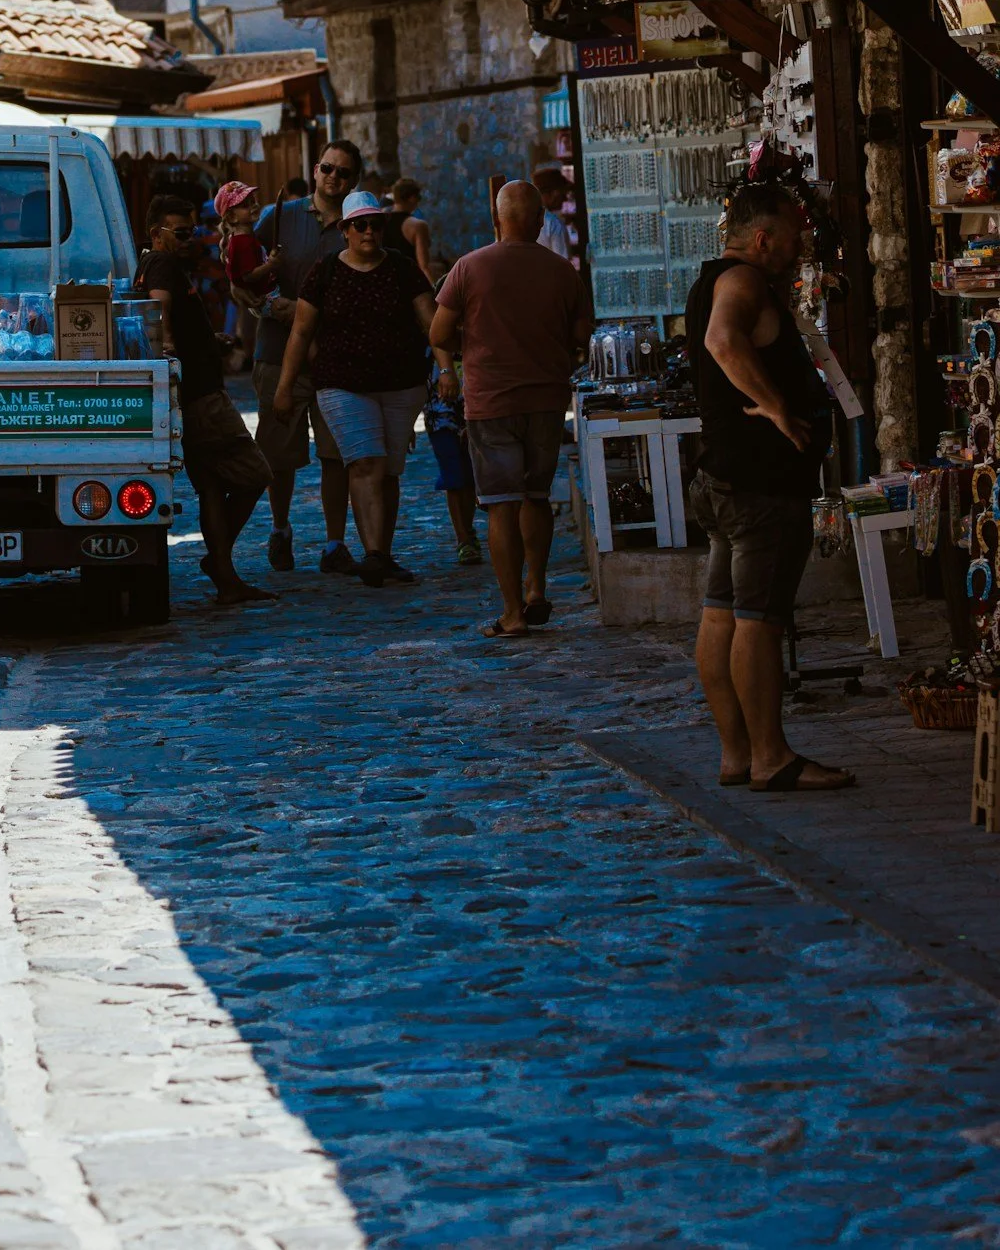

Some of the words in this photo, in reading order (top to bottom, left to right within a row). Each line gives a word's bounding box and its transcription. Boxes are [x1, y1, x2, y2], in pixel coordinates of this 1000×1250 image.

[644, 13, 708, 41] SHOP
[582, 44, 638, 69] SHELL
[20, 403, 55, 412] MARKET
[57, 399, 82, 408] Тел.:
[84, 398, 108, 408] 0700
[111, 398, 123, 407] 16
[125, 398, 144, 407] 003
[45, 414, 85, 425] ЗНАЯТ
[91, 538, 130, 555] KIA
